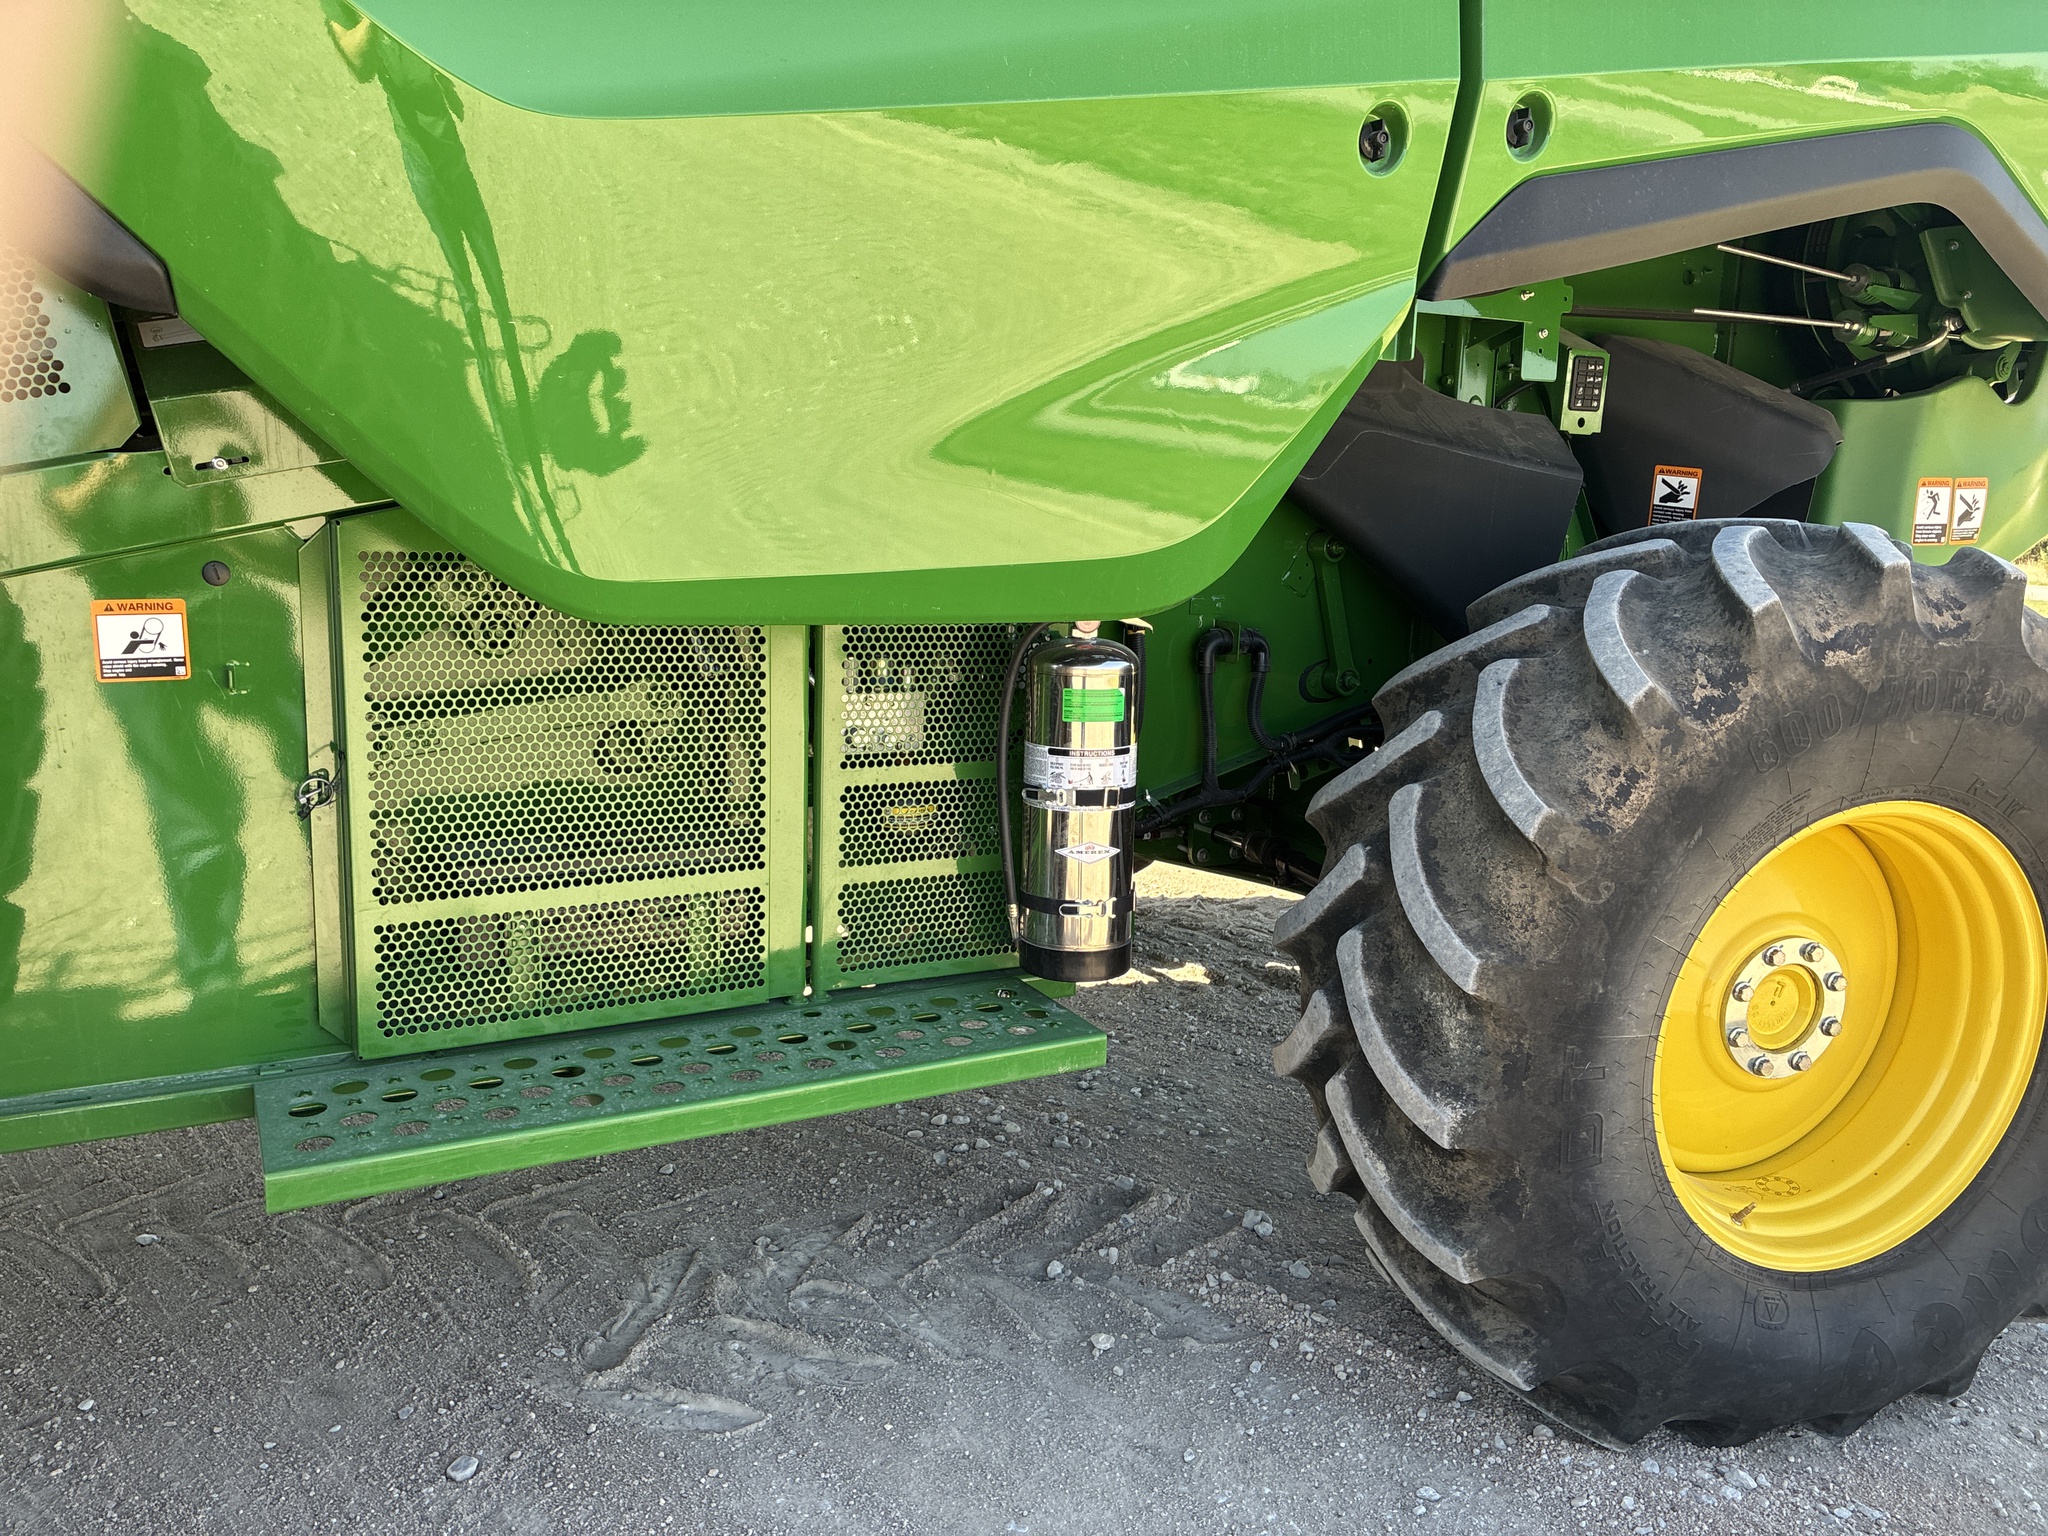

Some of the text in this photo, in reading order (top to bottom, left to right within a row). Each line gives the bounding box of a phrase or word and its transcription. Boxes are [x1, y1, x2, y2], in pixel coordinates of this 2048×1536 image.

[1665, 469, 1698, 477] WARNING
[117, 602, 174, 611] WARNING
[1603, 1199, 1665, 1308] TRACTION
